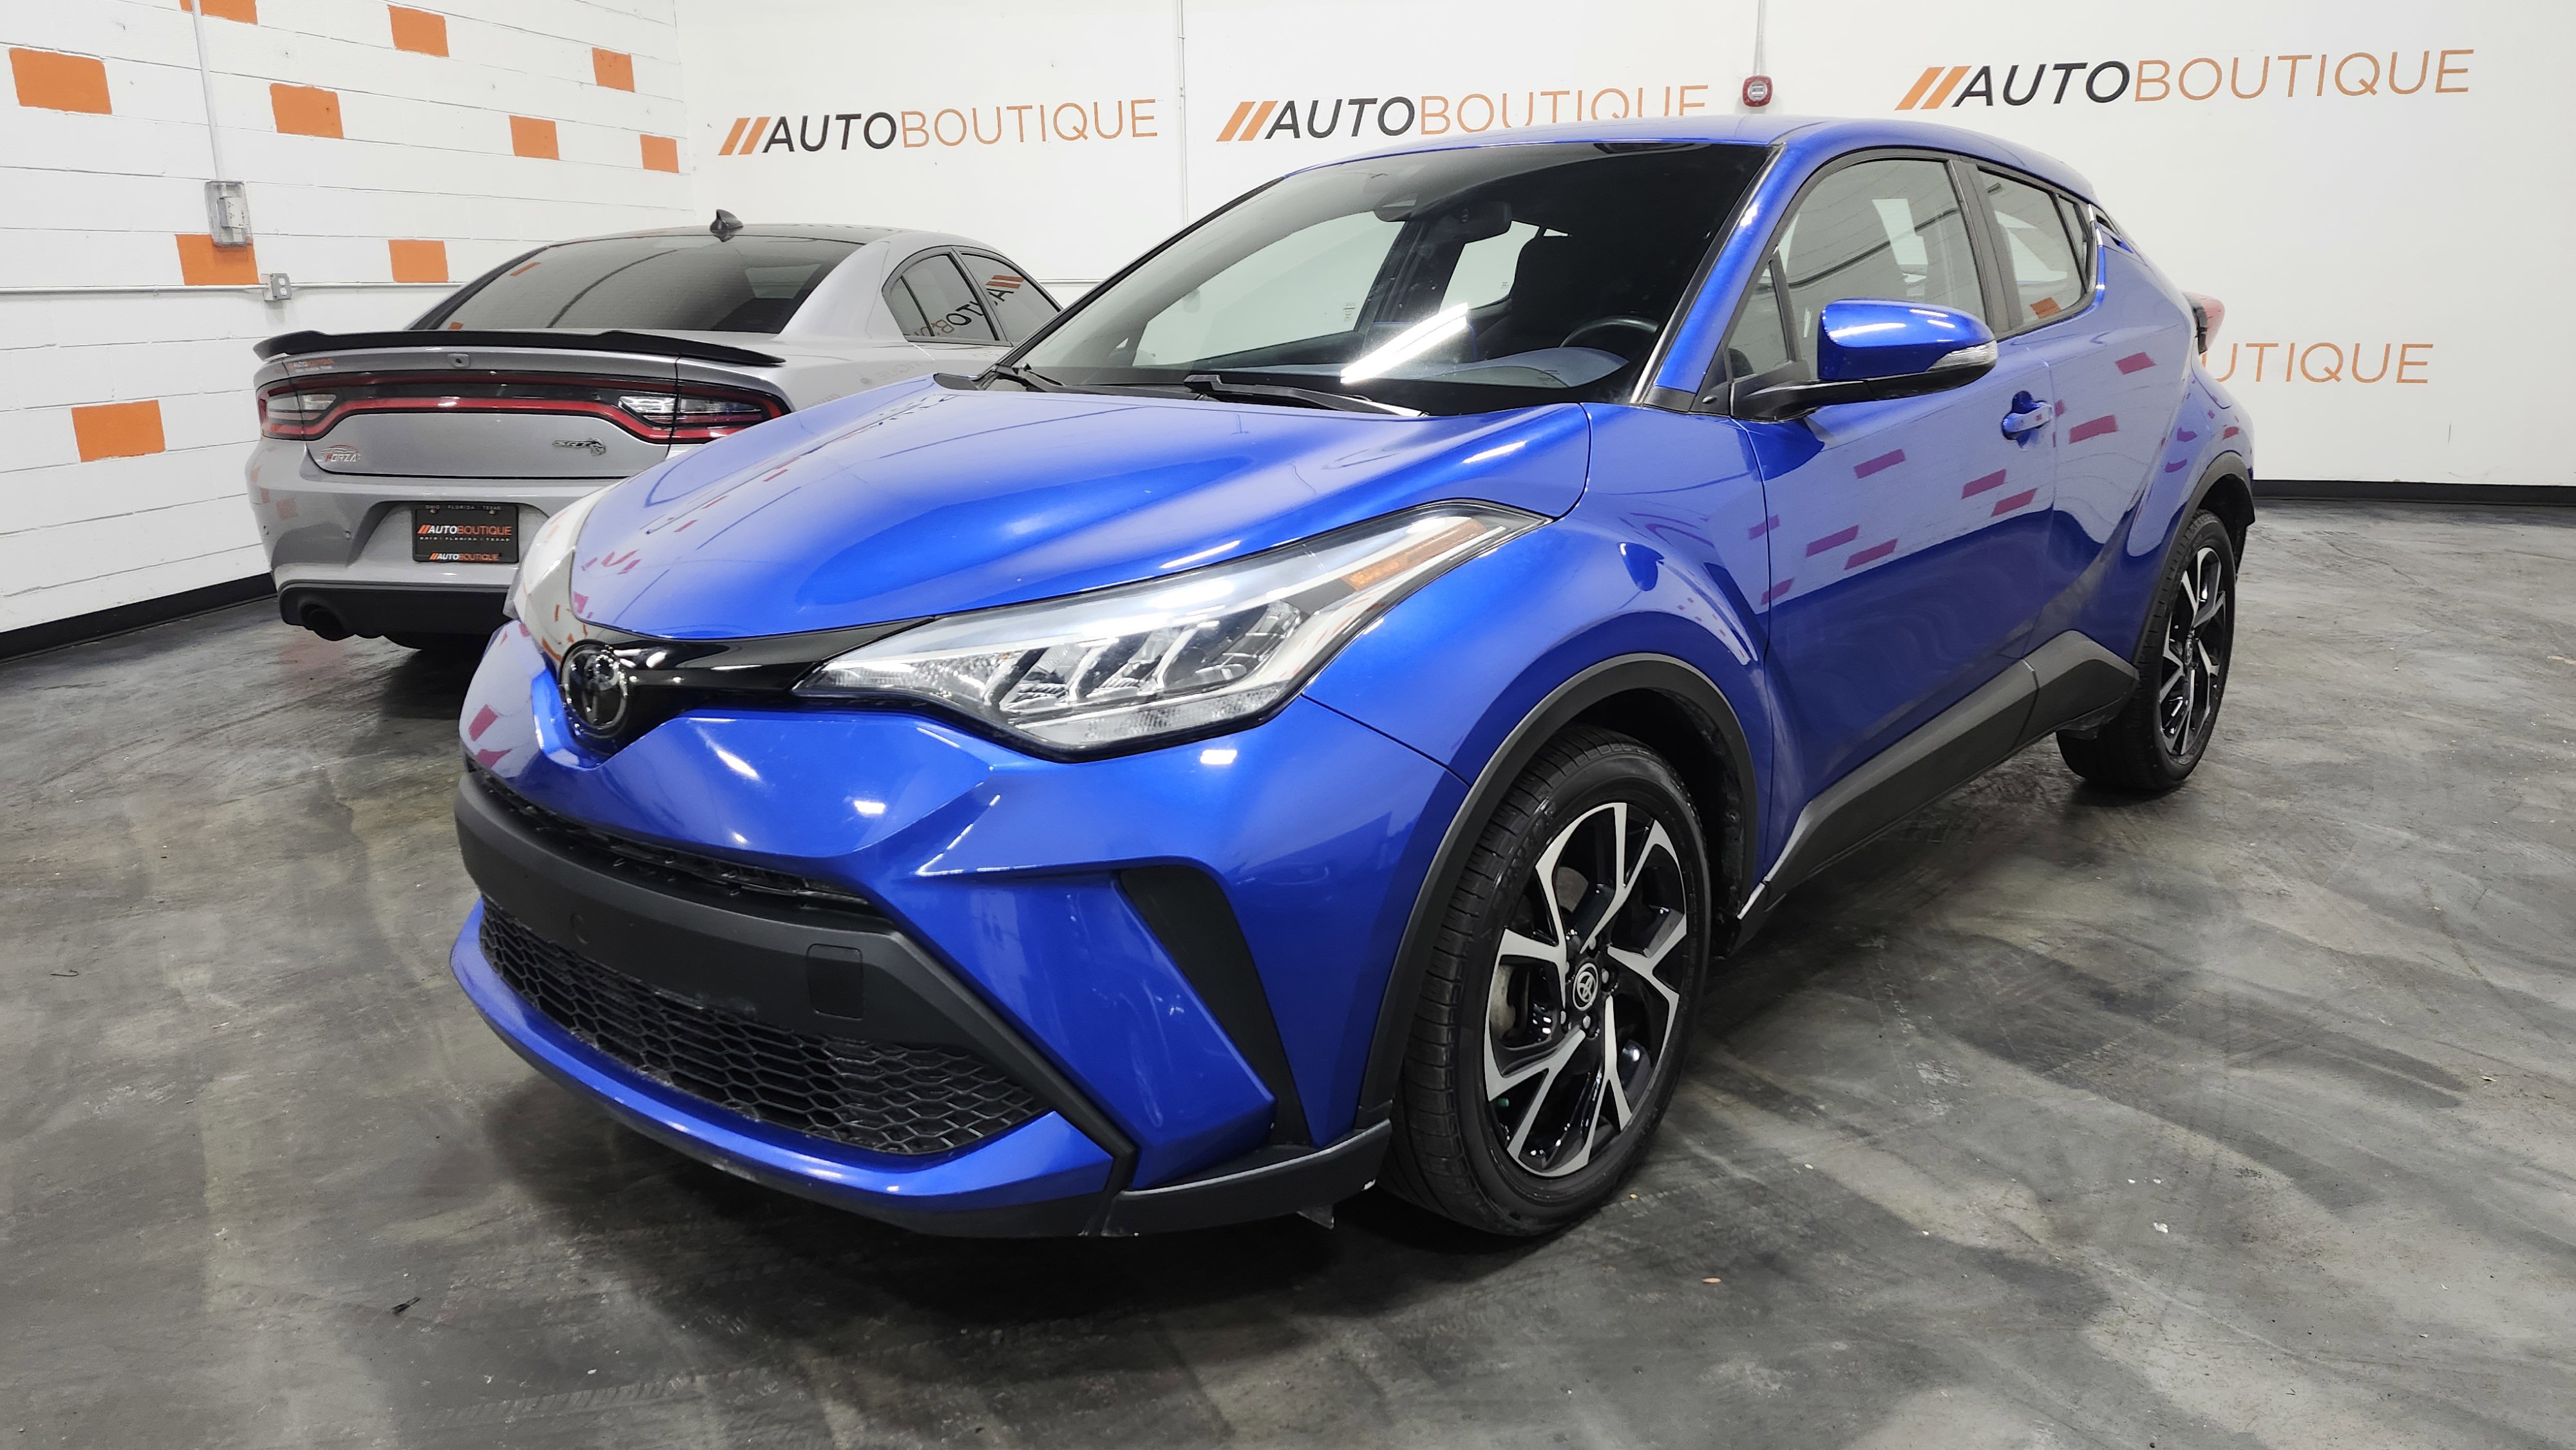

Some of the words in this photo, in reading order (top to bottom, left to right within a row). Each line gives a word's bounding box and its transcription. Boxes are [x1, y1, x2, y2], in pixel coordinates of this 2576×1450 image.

[1951, 49, 2474, 108] AUTOBOUTIQUE
[762, 99, 1158, 153] AUTOBOUTIQUE
[552, 439, 592, 449] SRT
[325, 453, 357, 462] FORZA
[428, 524, 513, 536] AUTOBOUTIQUE
[437, 552, 500, 561] AUTOBOUTIQUE
